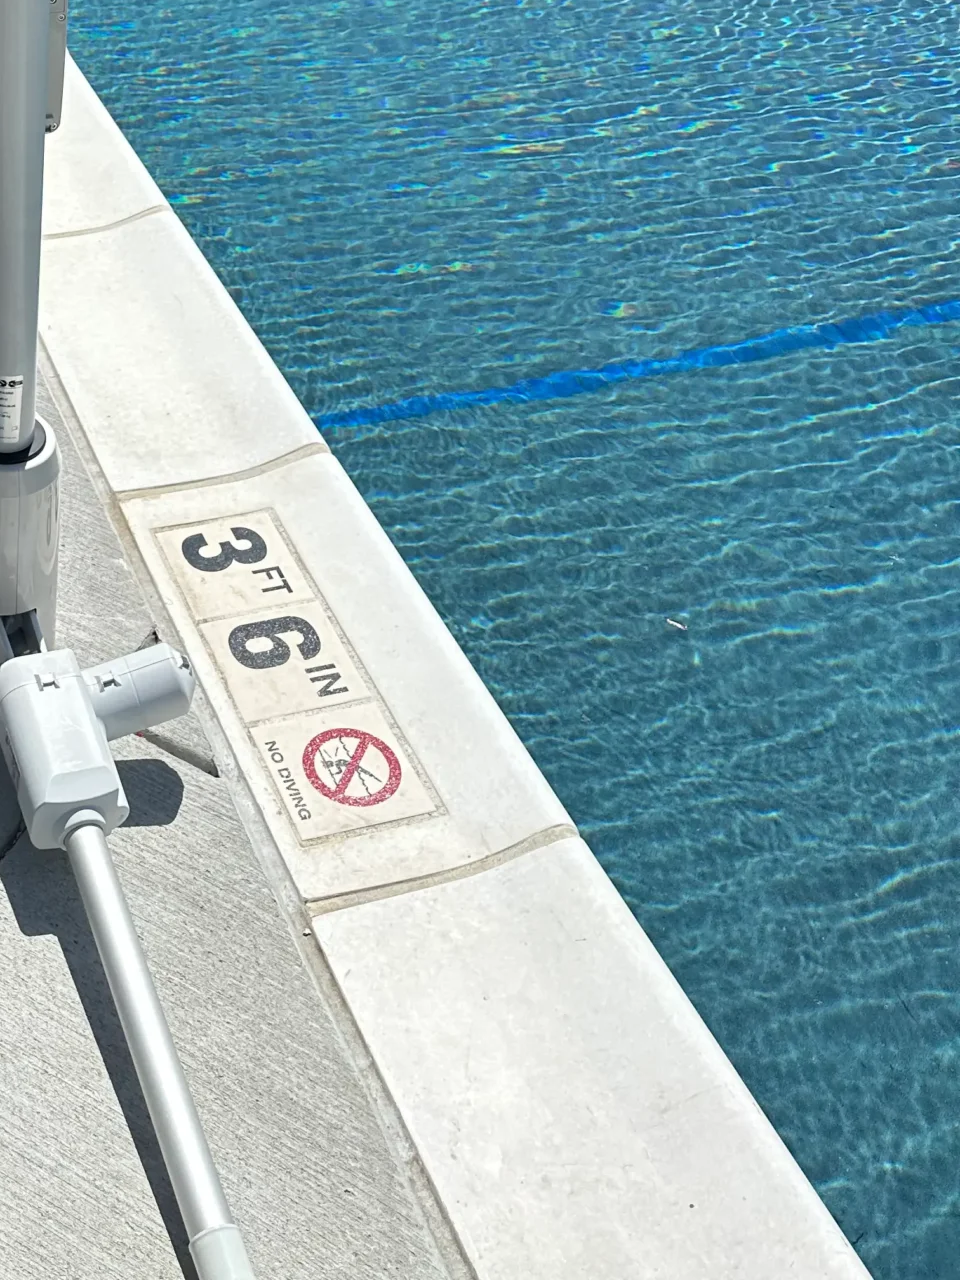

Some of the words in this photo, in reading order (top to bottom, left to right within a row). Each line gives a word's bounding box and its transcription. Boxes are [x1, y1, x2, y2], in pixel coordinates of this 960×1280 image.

[181, 526, 268, 573] 3
[251, 565, 293, 595] FT
[227, 615, 321, 670] 6
[304, 663, 349, 697] IN
[264, 740, 284, 764] NO
[278, 767, 312, 821] DIVING
